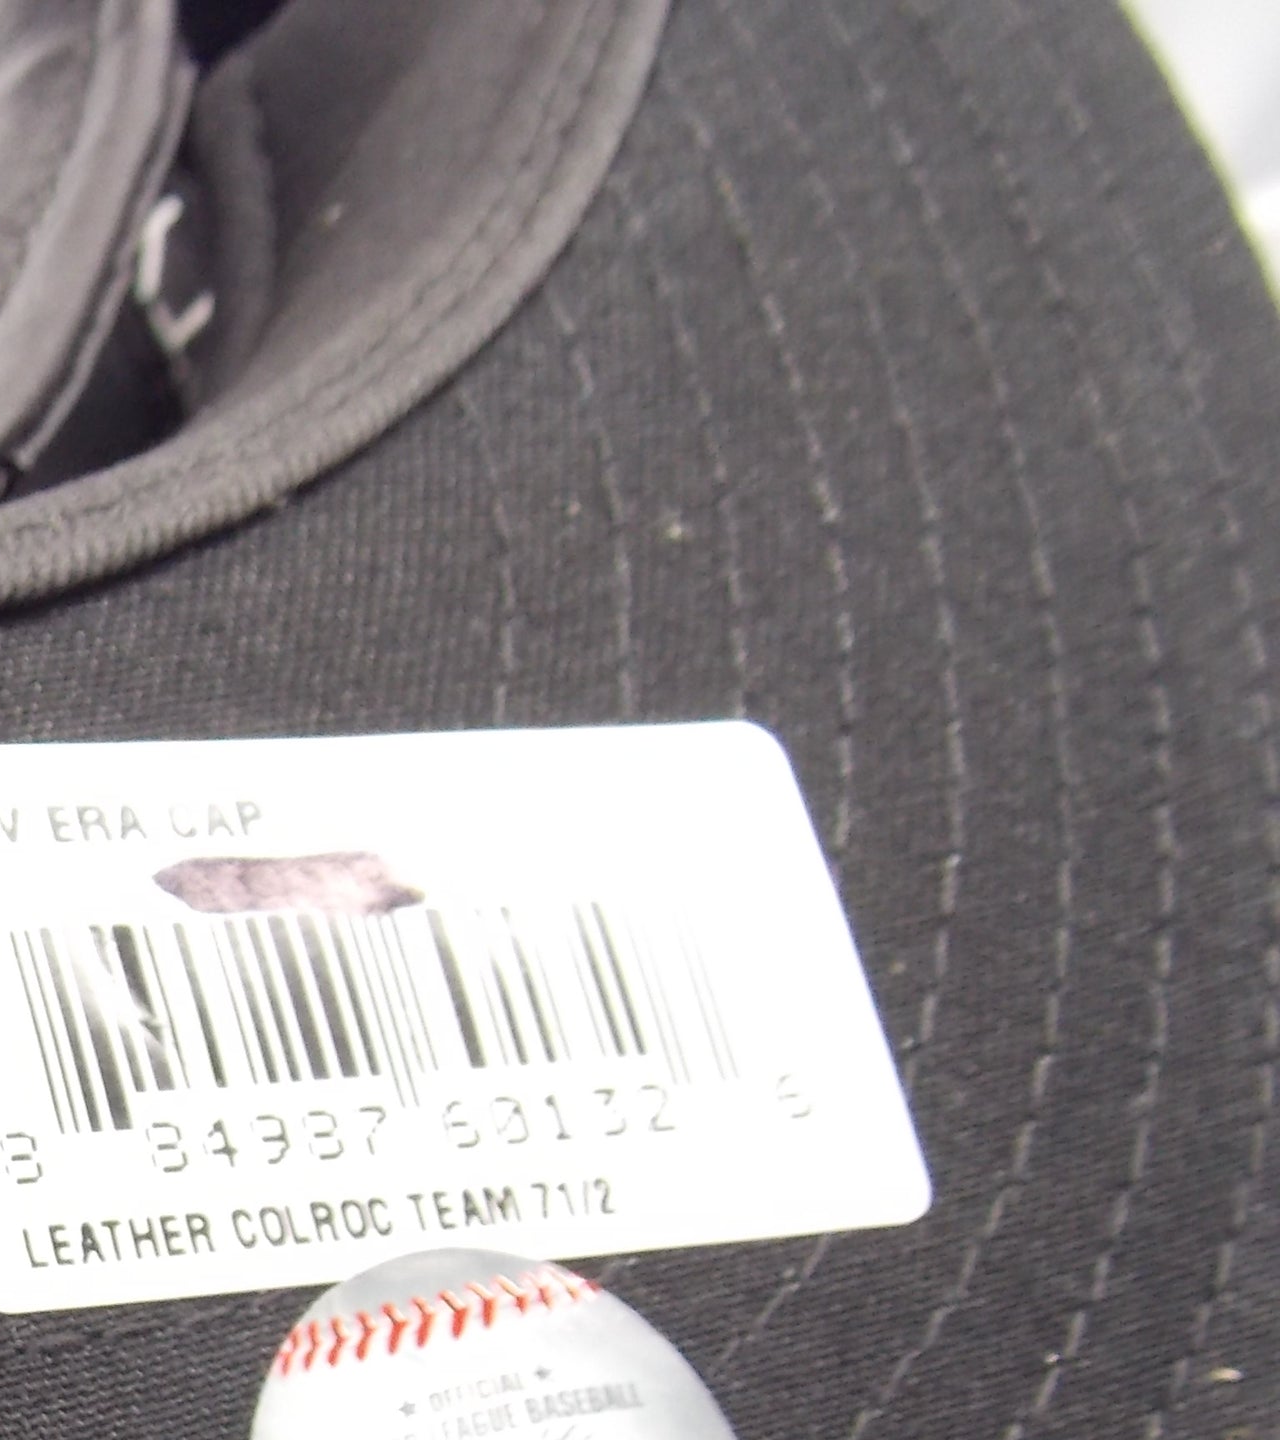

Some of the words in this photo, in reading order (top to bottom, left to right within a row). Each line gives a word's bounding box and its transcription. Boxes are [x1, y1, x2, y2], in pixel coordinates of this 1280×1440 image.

[46, 804, 148, 843] ERA
[167, 800, 264, 839] CAP
[21, 1212, 216, 1270] LEATHER
[230, 1197, 394, 1249] COLROC
[405, 1185, 524, 1233] TEAM
[427, 1371, 526, 1415] OFFICIAL
[523, 1381, 646, 1425] BASEBALL
